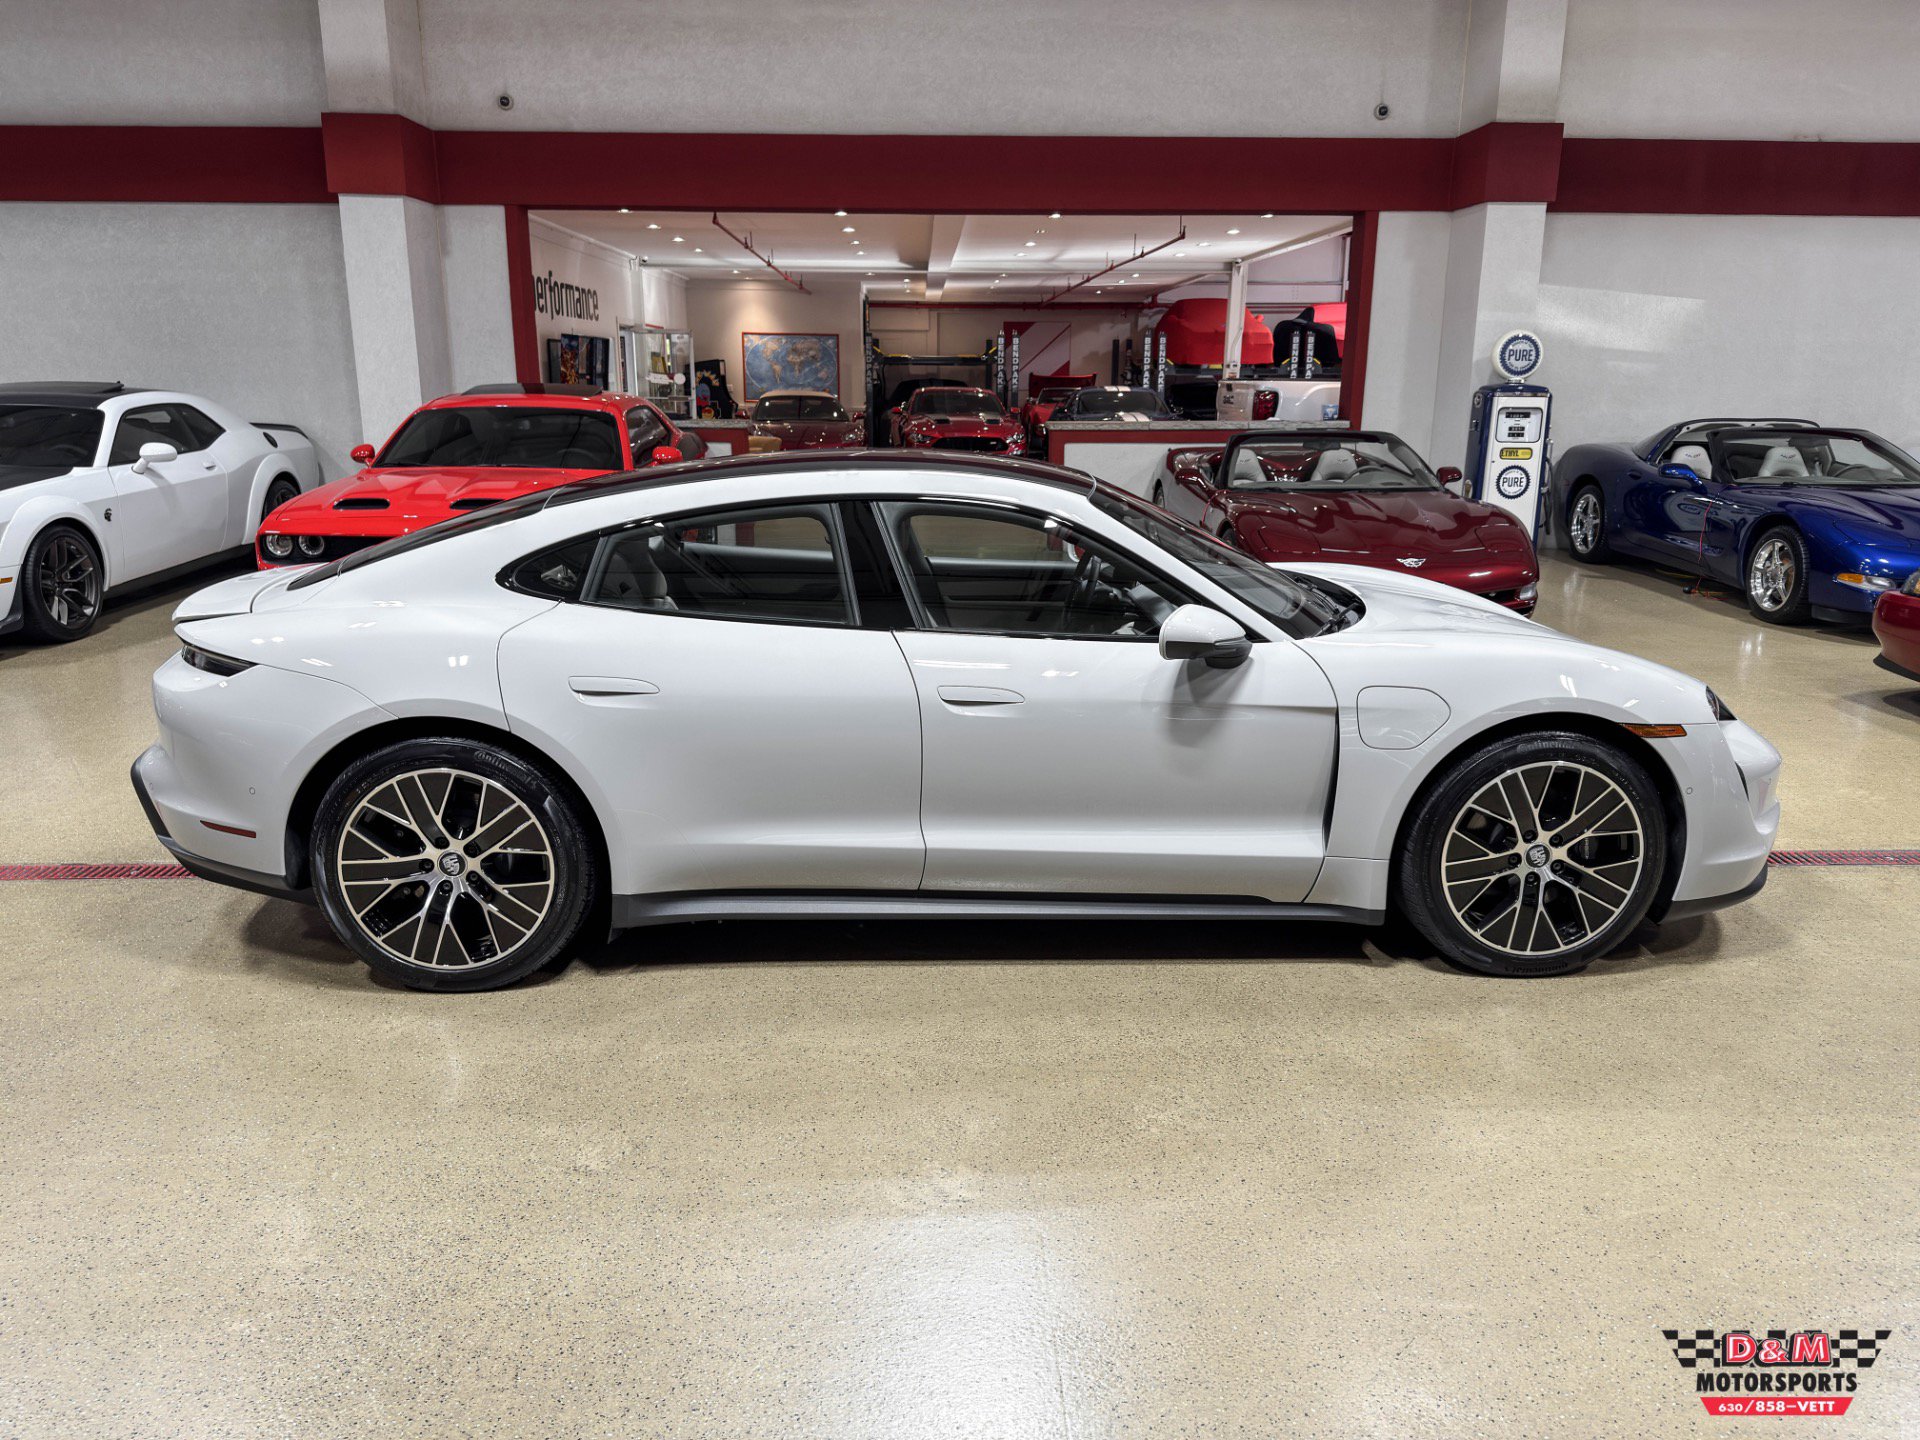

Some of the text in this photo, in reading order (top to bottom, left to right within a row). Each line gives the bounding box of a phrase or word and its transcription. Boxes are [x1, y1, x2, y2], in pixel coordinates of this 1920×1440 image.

[997, 337, 1005, 385] BENDPAK
[1012, 337, 1020, 385] BENDPAK
[1143, 337, 1151, 386] BENDPAK
[1158, 337, 1166, 386] BENDPAK
[1507, 349, 1533, 361] PURE
[1502, 477, 1524, 487] PURE
